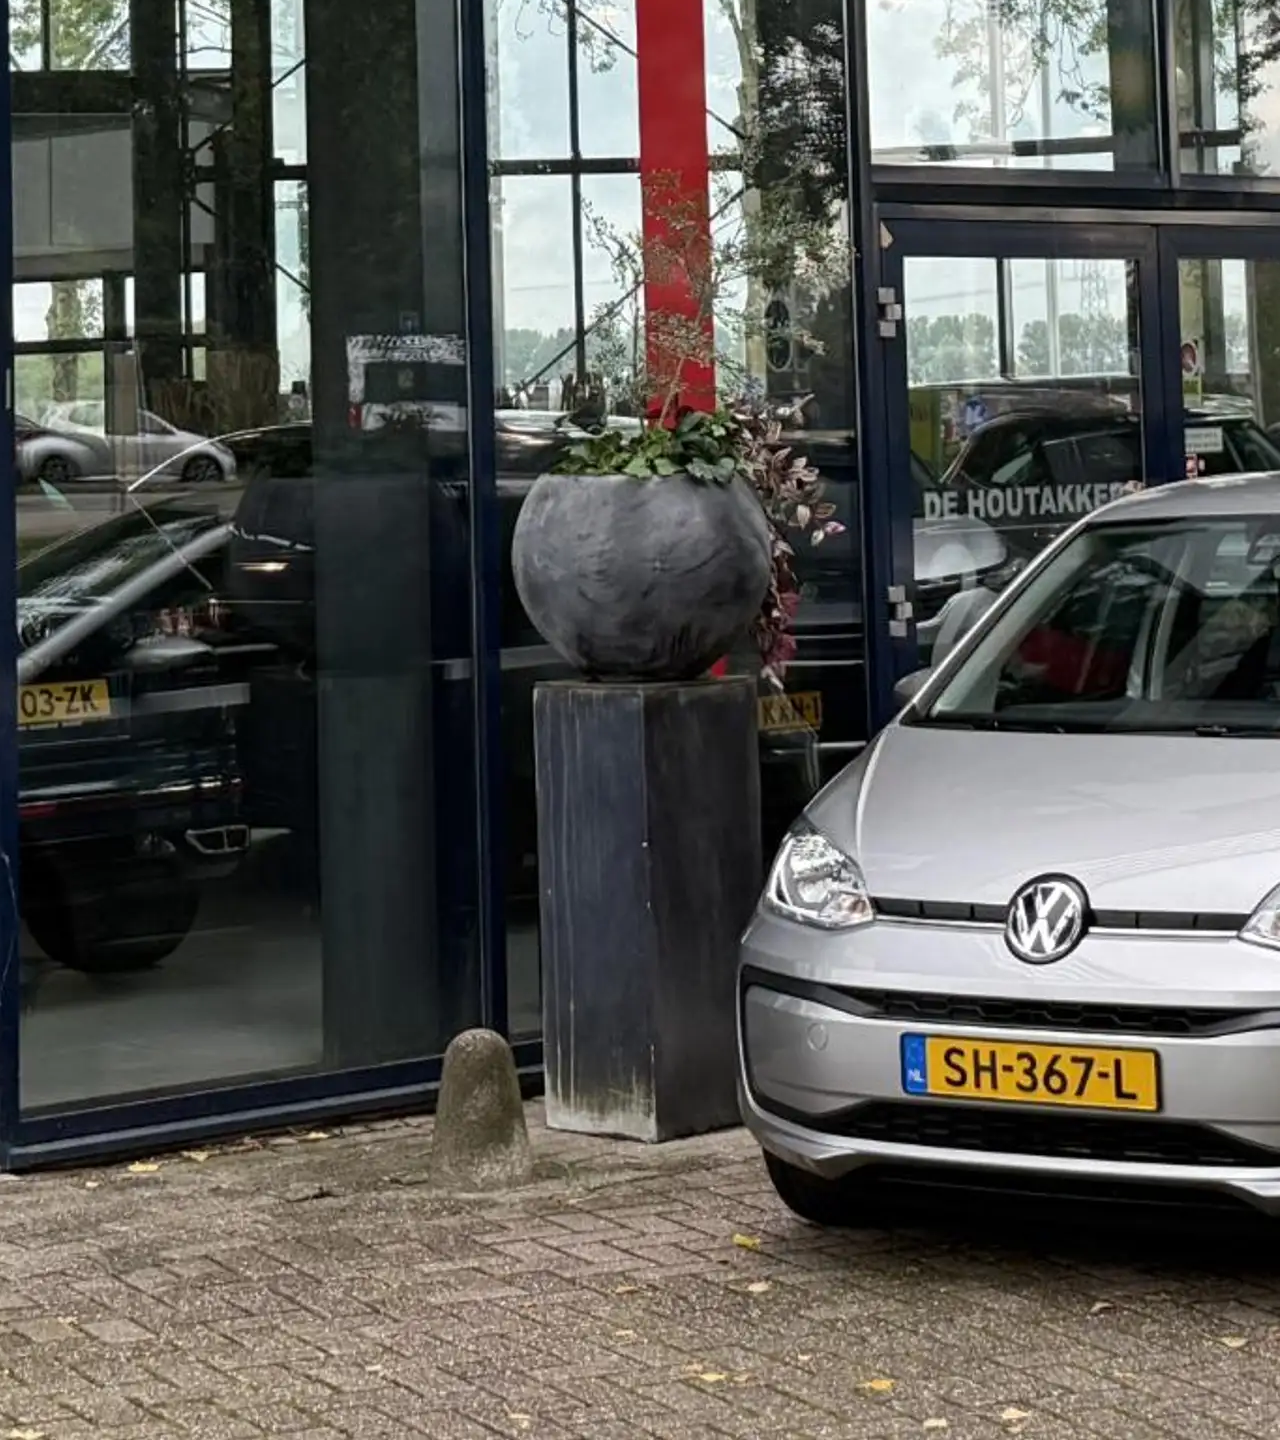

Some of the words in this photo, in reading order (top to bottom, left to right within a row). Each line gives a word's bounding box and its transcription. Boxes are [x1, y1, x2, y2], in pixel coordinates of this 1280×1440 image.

[923, 489, 959, 521] DE
[21, 684, 97, 718] 03-ZK
[942, 1046, 1138, 1101] SH-367-L
